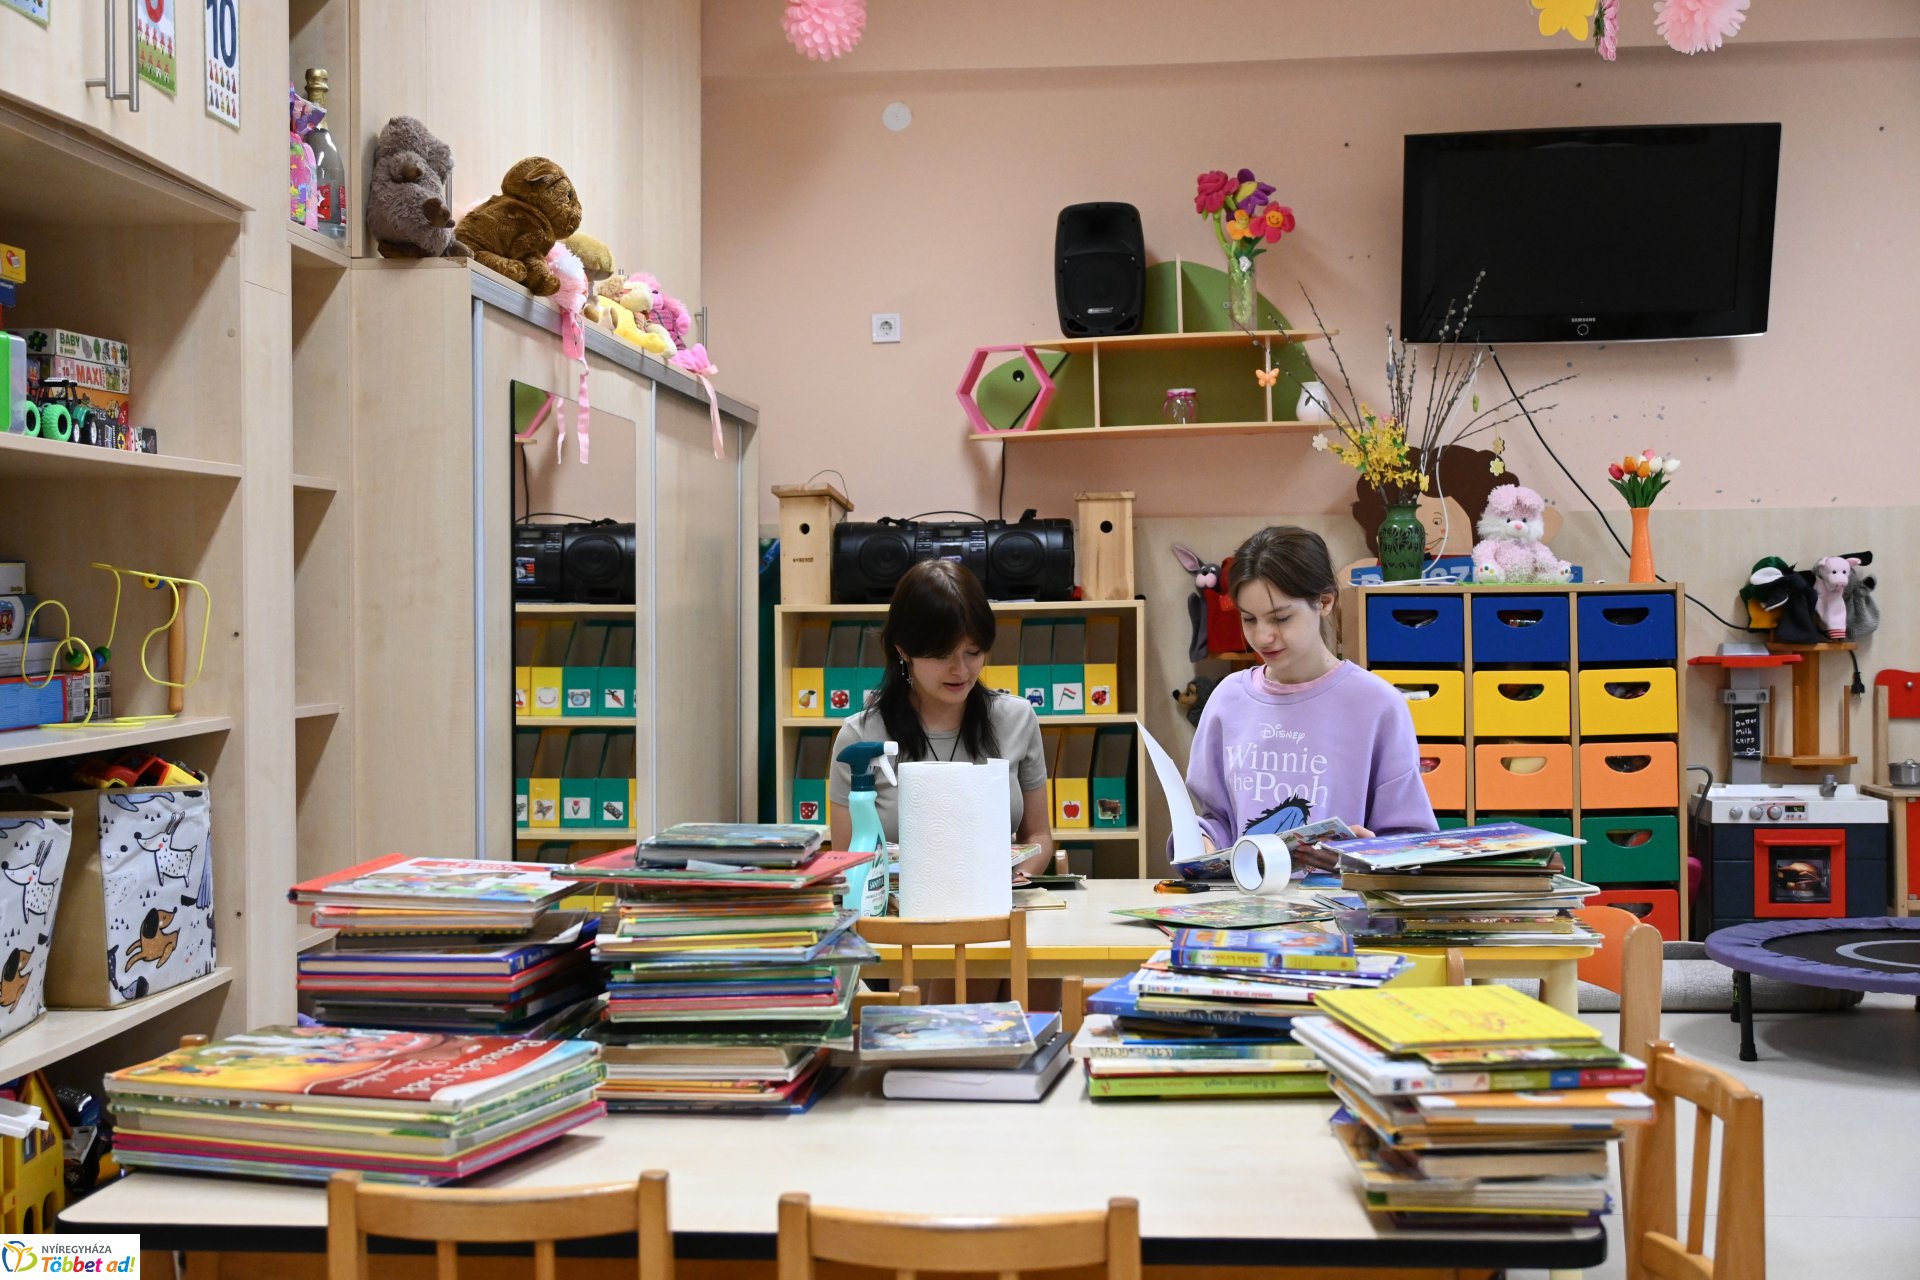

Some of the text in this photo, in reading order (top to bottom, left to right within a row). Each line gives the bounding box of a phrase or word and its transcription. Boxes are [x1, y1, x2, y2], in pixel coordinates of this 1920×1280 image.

[207, 0, 237, 69] 10
[60, 332, 81, 348] BABY
[76, 364, 103, 387] MAXI
[1225, 742, 1329, 775] Winnie
